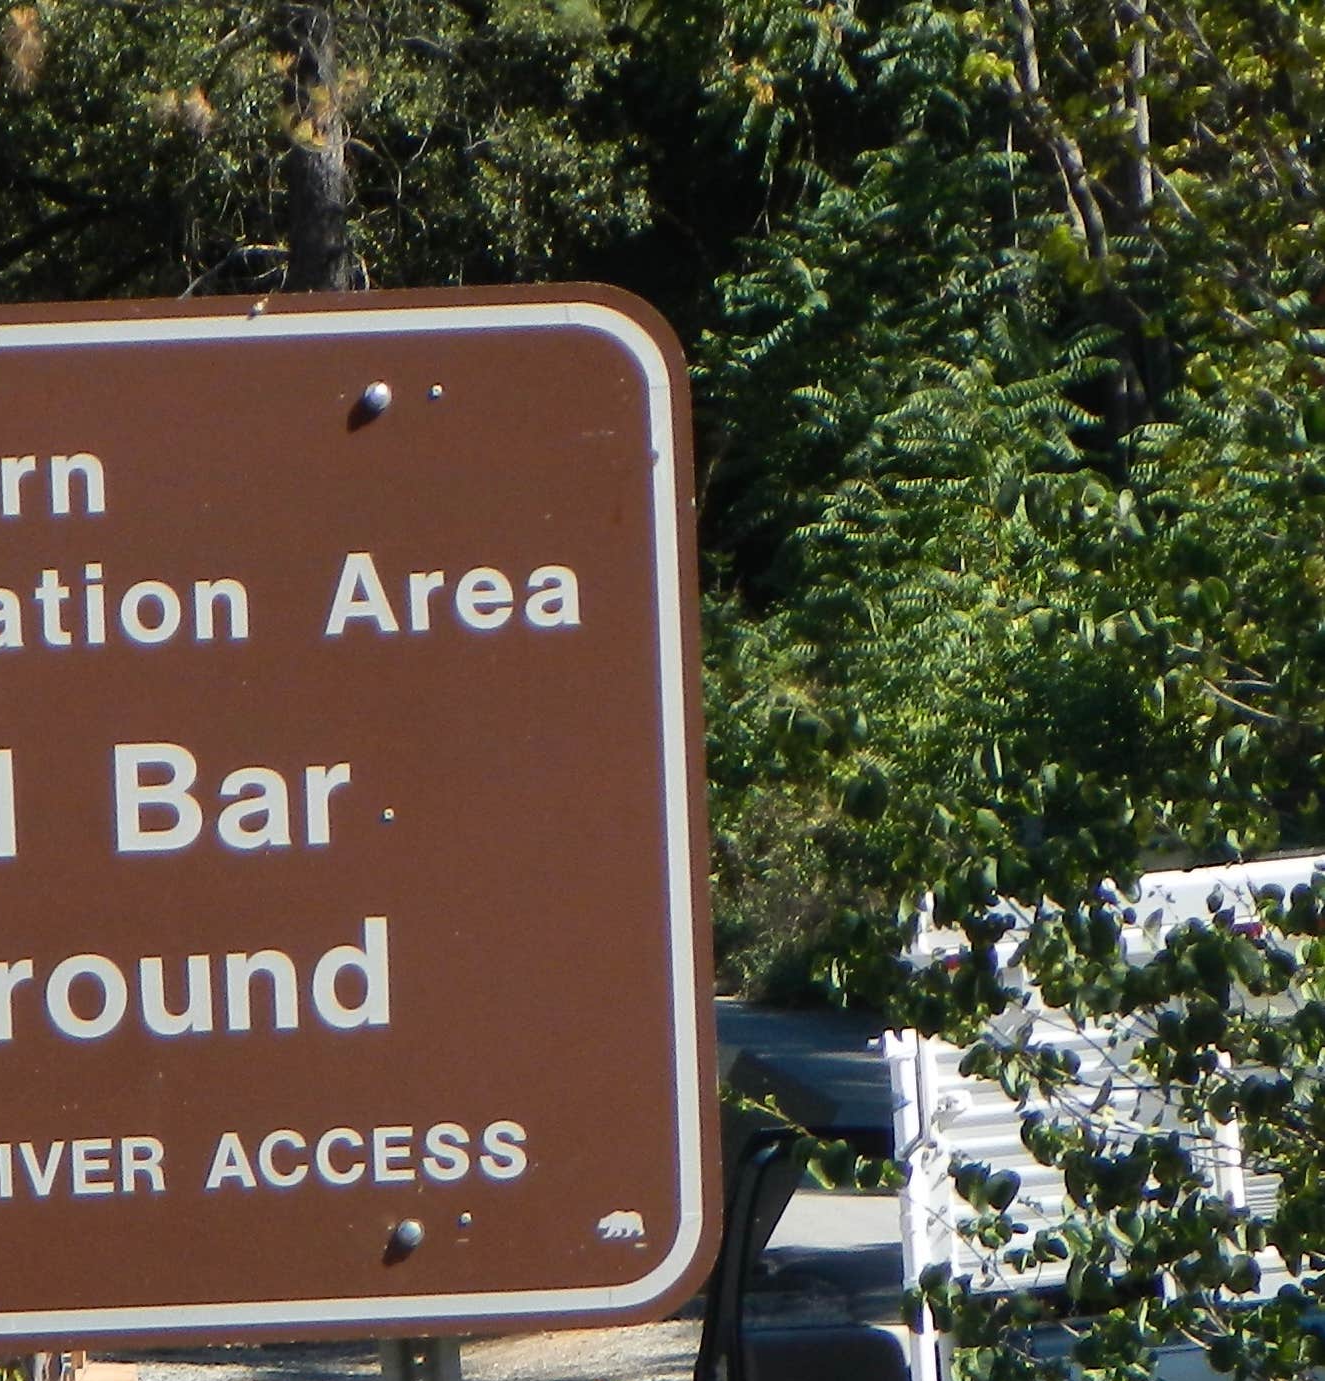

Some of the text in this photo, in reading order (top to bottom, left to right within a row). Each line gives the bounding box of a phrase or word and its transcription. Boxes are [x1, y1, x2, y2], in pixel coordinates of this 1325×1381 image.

[324, 551, 581, 636] Area
[113, 742, 352, 853] Bar
[205, 1119, 528, 1190] ACCESS
